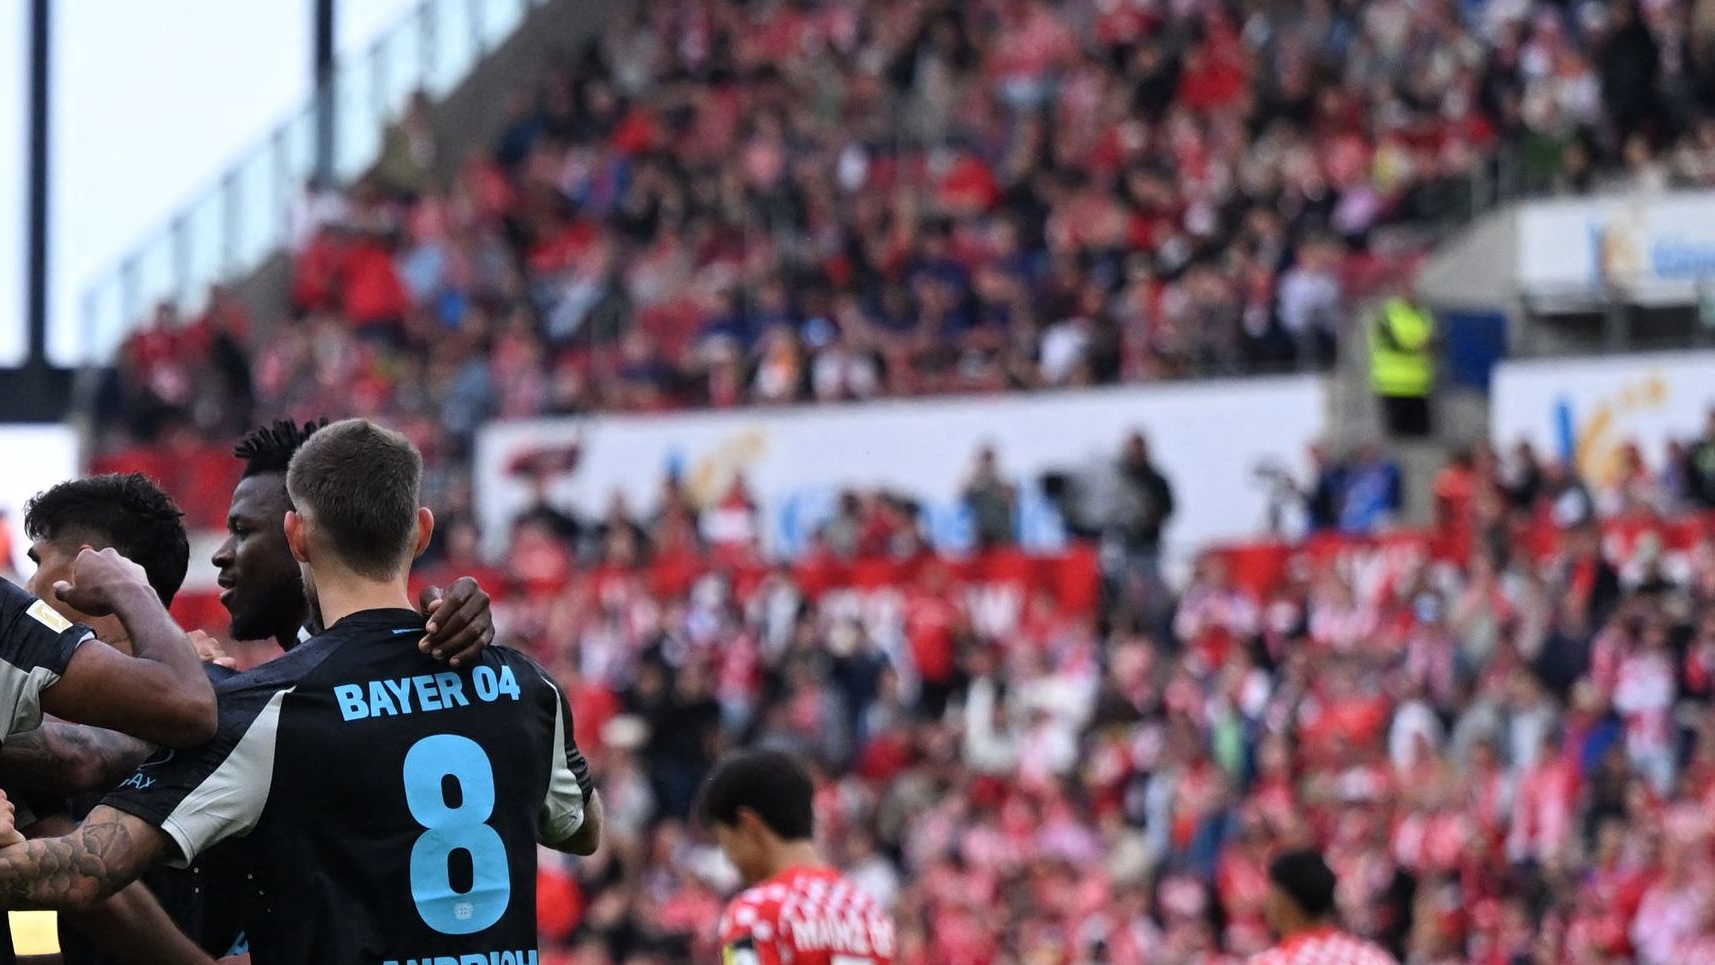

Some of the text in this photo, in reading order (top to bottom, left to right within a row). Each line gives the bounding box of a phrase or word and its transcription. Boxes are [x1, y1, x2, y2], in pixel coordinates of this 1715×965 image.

[333, 664, 521, 722] BAYER 04
[402, 733, 511, 936] 8
